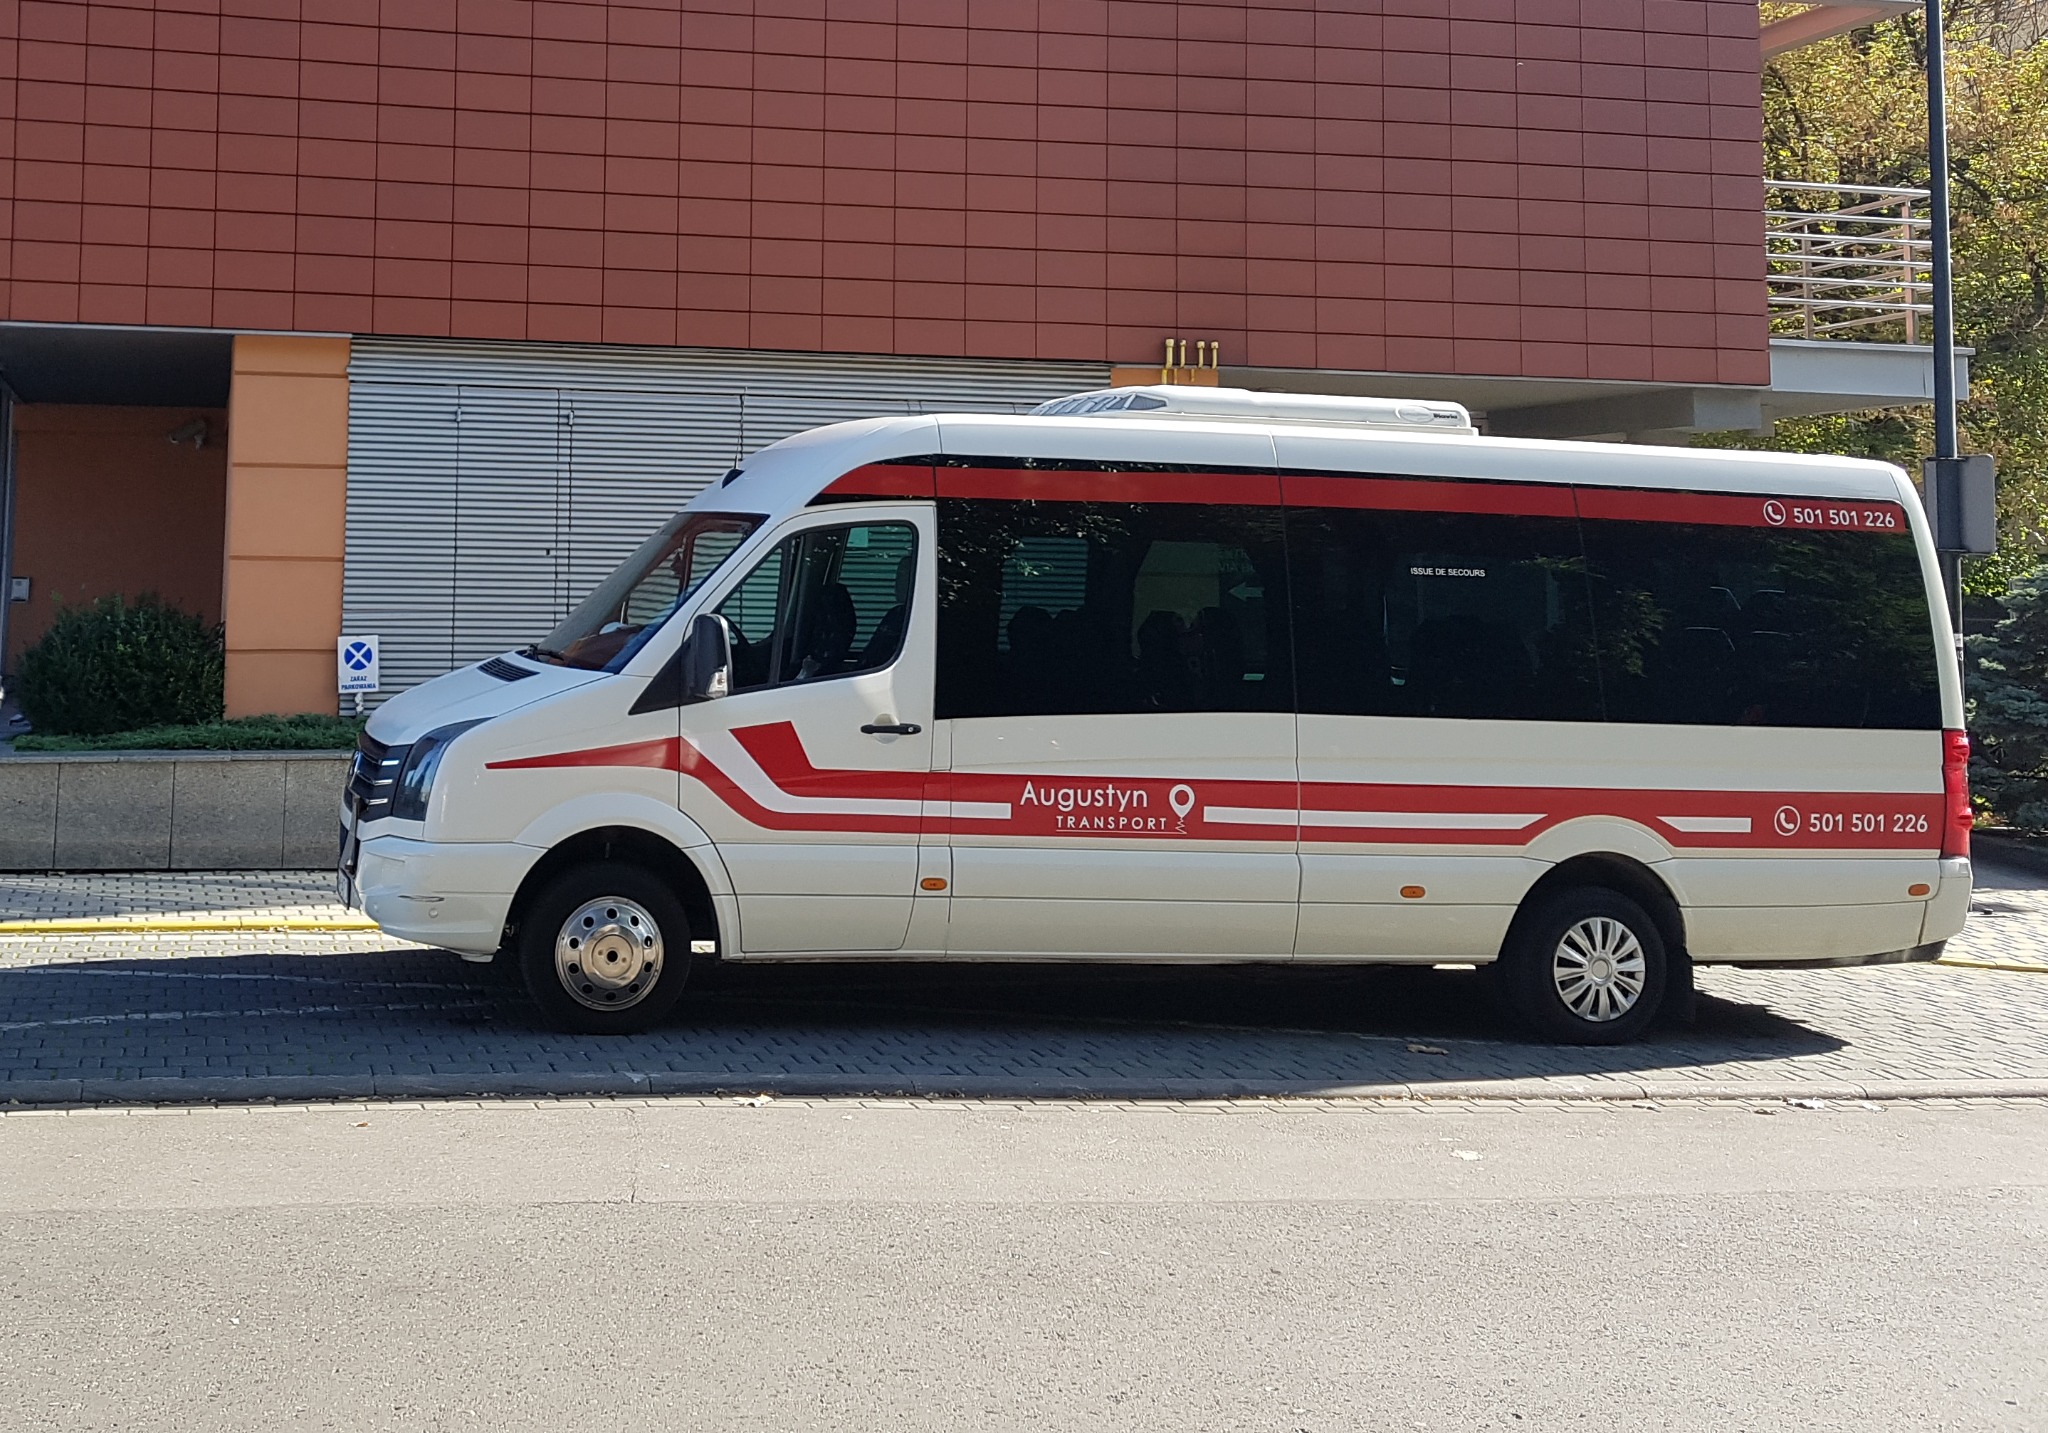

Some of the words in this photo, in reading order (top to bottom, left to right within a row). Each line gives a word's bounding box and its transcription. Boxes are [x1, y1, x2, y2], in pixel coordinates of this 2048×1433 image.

[1793, 507, 1823, 524] 501
[1829, 509, 1859, 526] 501
[1864, 511, 1895, 528] 226
[1410, 567, 1434, 575] ISSUE
[1435, 568, 1447, 576] DE
[1447, 568, 1486, 577] SECOURS
[1019, 780, 1148, 812] Augustyn
[1056, 815, 1167, 830] TRANSPORT
[1809, 813, 1843, 832] 501
[1851, 813, 1885, 832] 501
[1892, 813, 1929, 833] 226
